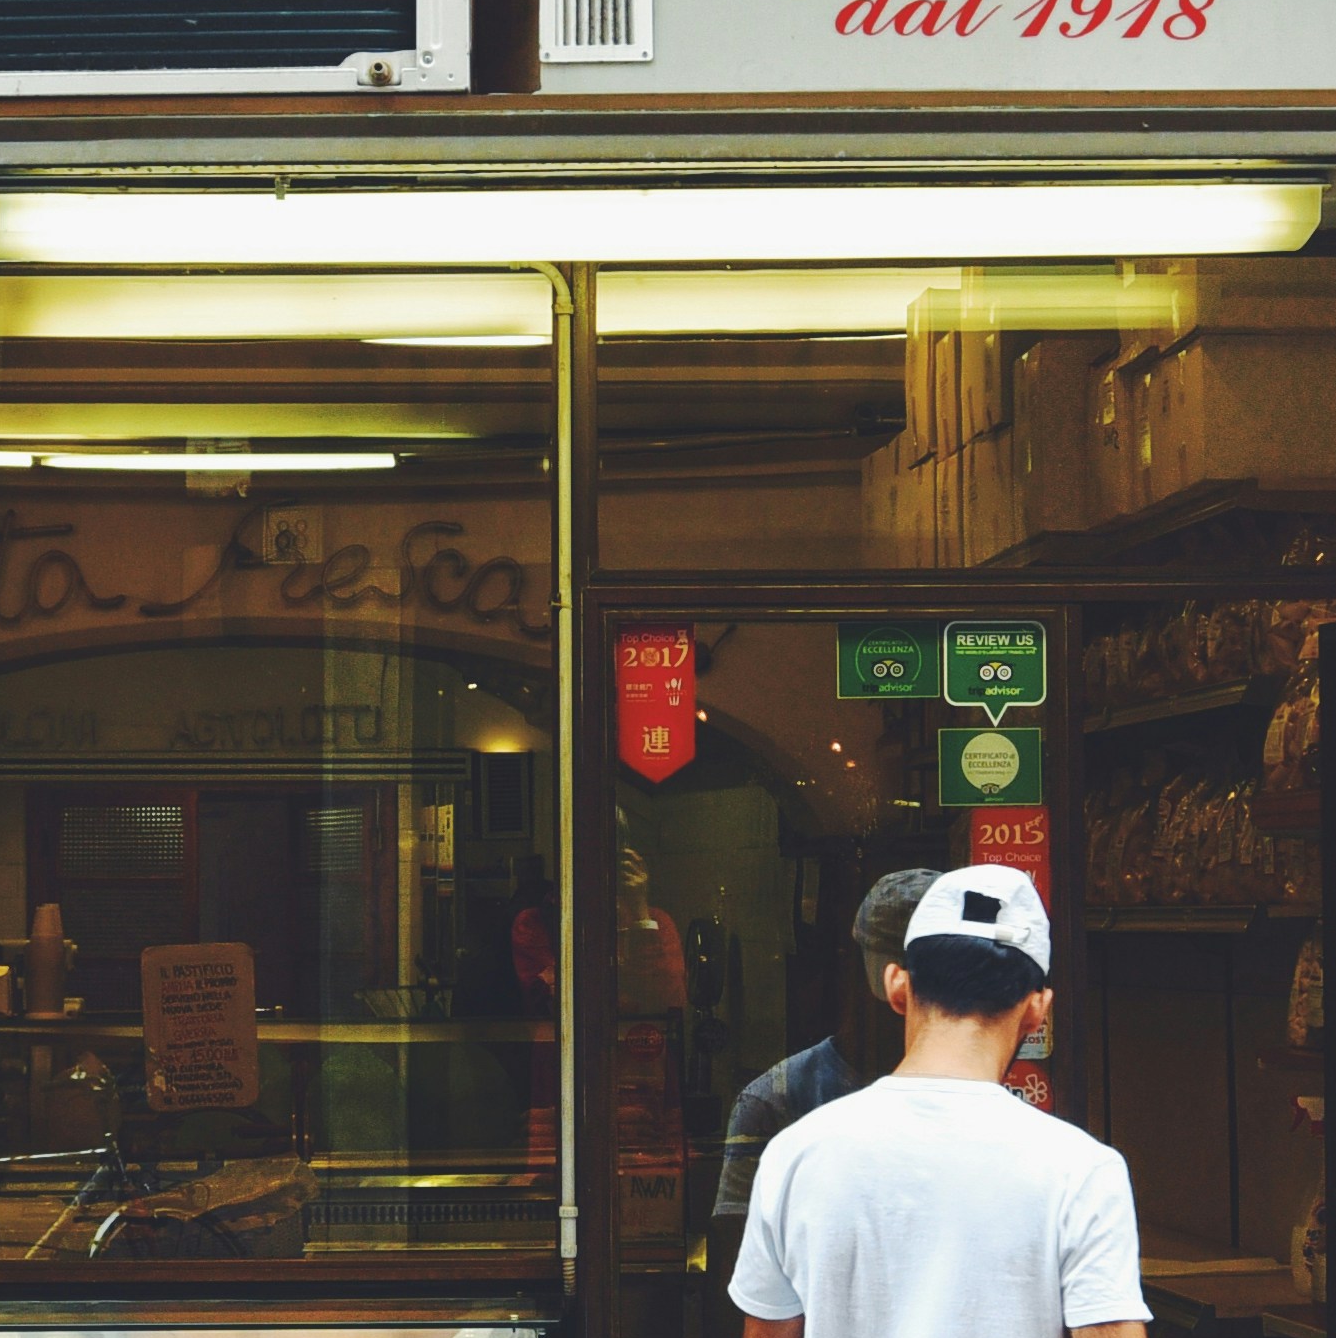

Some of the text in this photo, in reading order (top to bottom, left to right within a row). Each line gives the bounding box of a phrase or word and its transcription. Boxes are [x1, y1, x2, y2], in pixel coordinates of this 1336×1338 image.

[621, 633, 676, 644] Top Choice
[956, 634, 1034, 646] REVIEW US
[623, 643, 689, 668] 2017
[863, 646, 914, 654] ECCELLENZA
[979, 823, 1045, 845] 2015
[982, 851, 1042, 863] Top Choice
